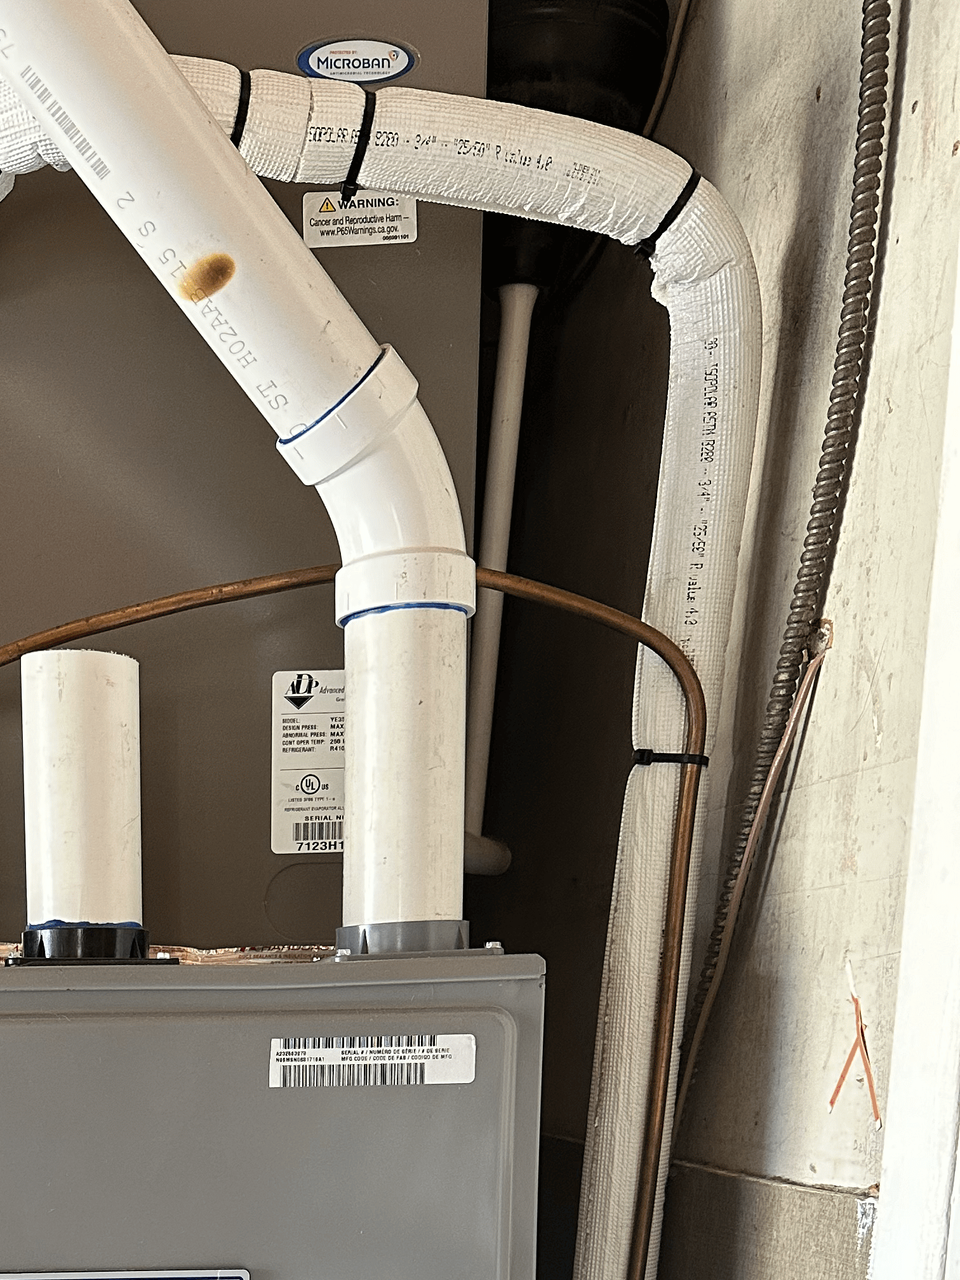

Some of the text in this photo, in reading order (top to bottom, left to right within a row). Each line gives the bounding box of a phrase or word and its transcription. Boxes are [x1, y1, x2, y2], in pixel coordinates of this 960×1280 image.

[337, 196, 399, 210] WARNING:
[309, 213, 403, 227] Cancer and Reproductive Harm
[284, 673, 345, 696] ADP Advanced
